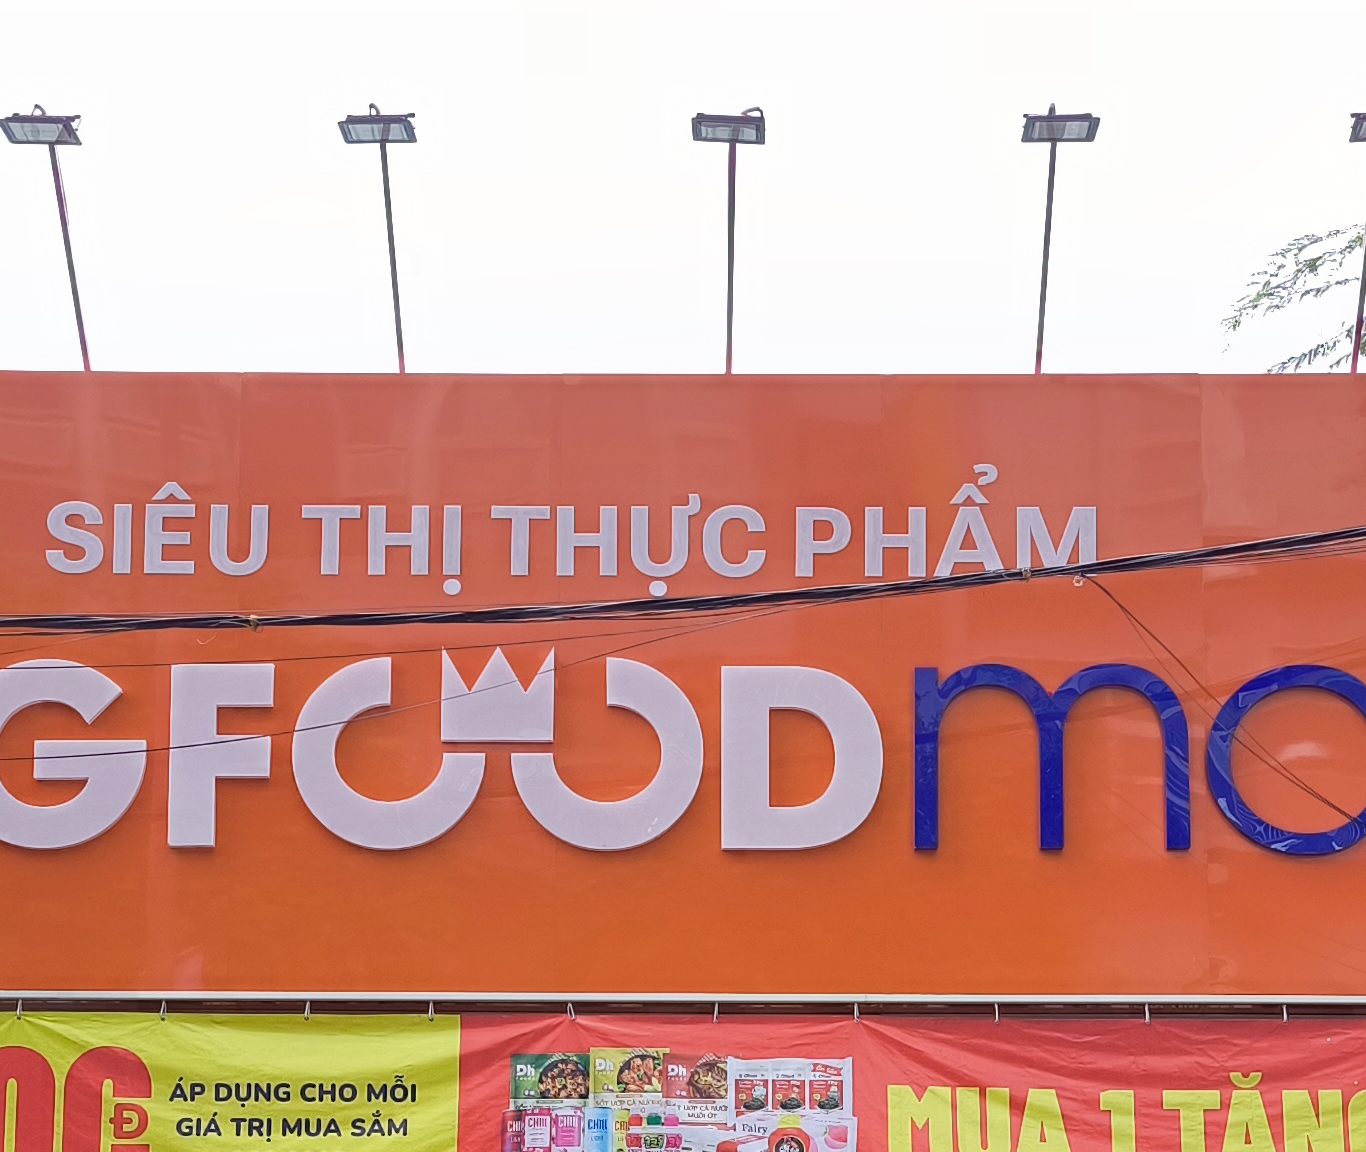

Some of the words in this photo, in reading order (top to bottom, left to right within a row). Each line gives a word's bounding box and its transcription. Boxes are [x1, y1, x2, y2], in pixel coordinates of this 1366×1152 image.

[46, 481, 270, 576] SIÊU
[302, 505, 464, 597] THỊ
[491, 493, 769, 599] THỰC
[794, 462, 1100, 580] PHẨM
[168, 1077, 207, 1104] ÁP
[214, 1081, 292, 1110] DỤNG
[299, 1081, 359, 1104] CHO
[367, 1073, 418, 1104] MỖI
[176, 1112, 223, 1138] GIÁ
[230, 1117, 273, 1144] TRỊ
[287, 1117, 343, 1138] MUA
[350, 1110, 409, 1138] SẮM
